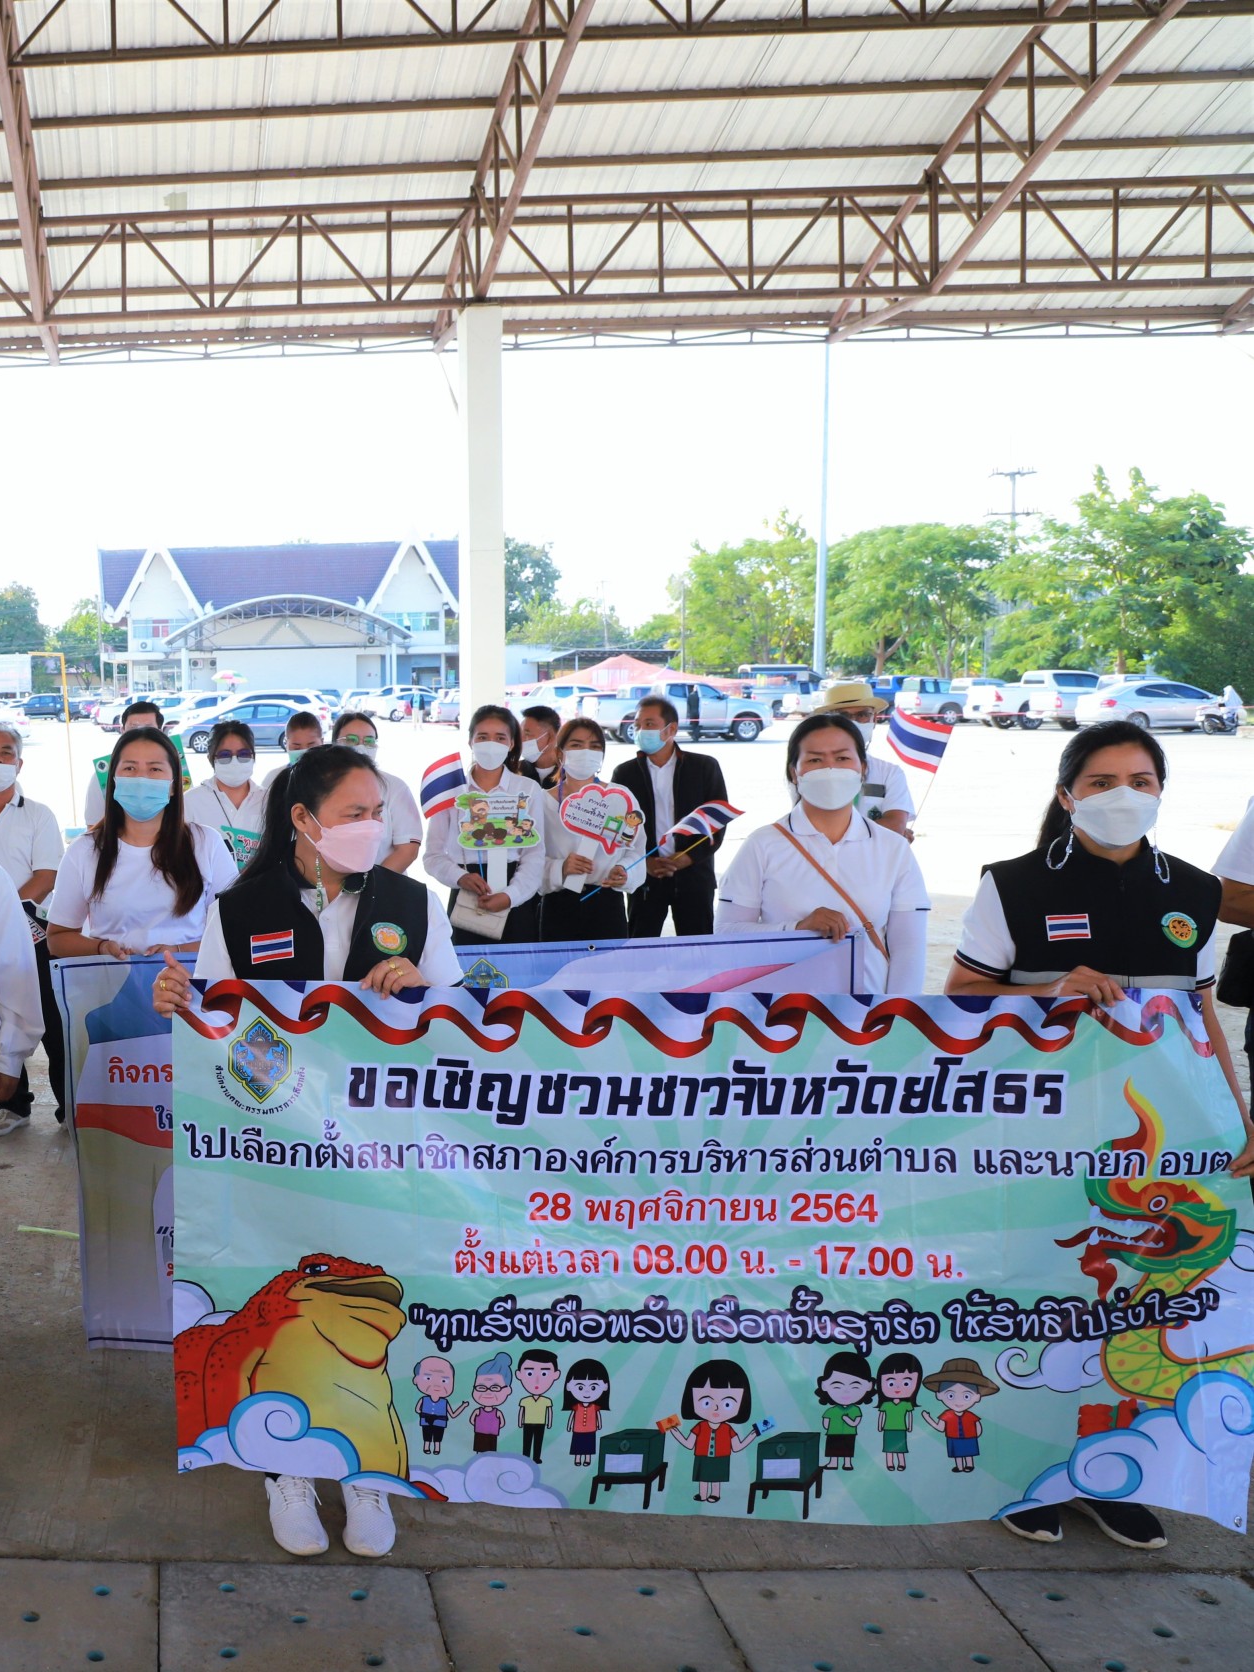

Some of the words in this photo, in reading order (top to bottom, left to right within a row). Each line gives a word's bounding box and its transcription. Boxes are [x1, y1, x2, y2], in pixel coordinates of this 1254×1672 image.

[349, 1058, 1064, 1125] ขอเชิญชวนชาวจังหวัดยโสธร
[183, 1120, 958, 1175] ไปเลือกตั้งสมาชิกสภาองค์การบริหารส่วนตำบล
[974, 1148, 1145, 1177] และนายก
[528, 1191, 572, 1222] 28
[584, 1190, 777, 1231] พฤศจิกายน
[790, 1192, 879, 1223] 2564
[455, 1227, 620, 1275] ตั้งแต่เวลา
[633, 1243, 728, 1276] 08.00
[740, 1248, 776, 1276] น.
[814, 1246, 914, 1278] 17.00
[926, 1251, 964, 1278] น.
[413, 1297, 684, 1348] "ทุกเสียงคือพลัง
[697, 1291, 936, 1353] เลือกตั้งสุจริต
[949, 1290, 1216, 1341] ใช้สิทธิโปร่งใส"
